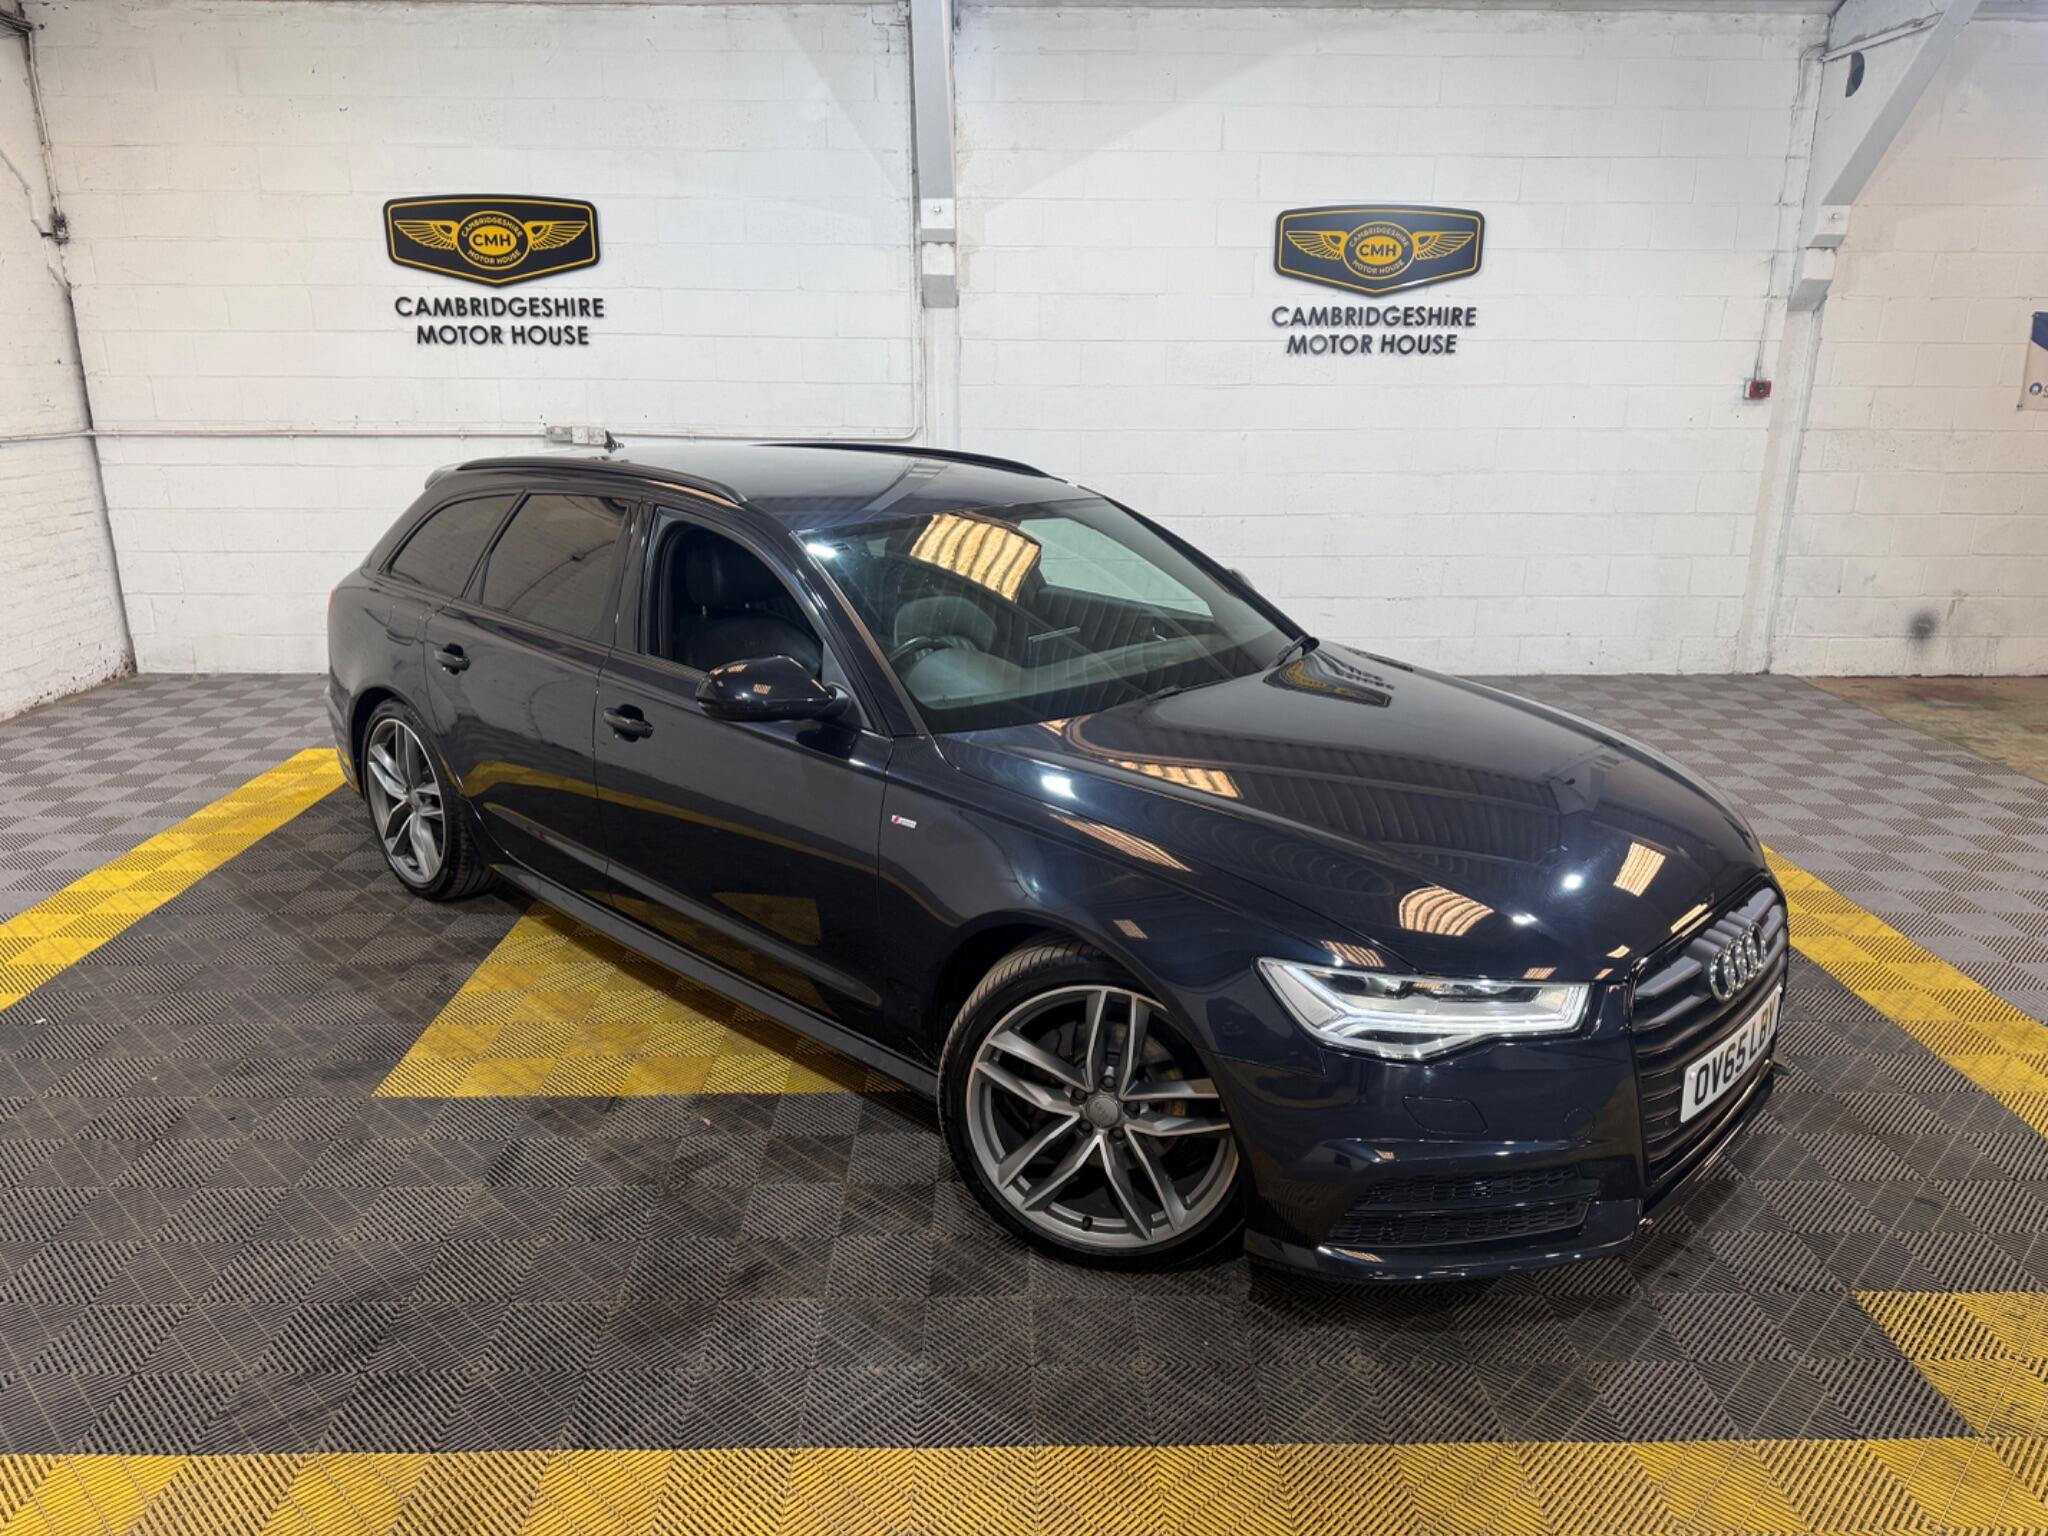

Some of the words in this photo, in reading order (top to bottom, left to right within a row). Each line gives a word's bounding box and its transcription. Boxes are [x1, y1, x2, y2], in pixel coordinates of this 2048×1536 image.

[461, 216, 523, 238] CAMBRIDGESHIRE
[472, 233, 511, 247] CMH
[1360, 243, 1396, 257] CMH
[467, 249, 496, 264] MOTOR
[496, 248, 521, 264] HOUSE
[1352, 259, 1378, 274] MOTOR
[1379, 259, 1405, 274] HOUSE
[394, 296, 605, 318] CAMBRIDGESHIRE
[1271, 306, 1478, 328] CAMBRIDGESHIRE
[416, 324, 504, 346] MOTOR
[511, 325, 590, 346] HOUSE
[1286, 334, 1374, 355] MOTOR
[1380, 334, 1459, 355] HOUSE
[1694, 1031, 1748, 1106] OV65
